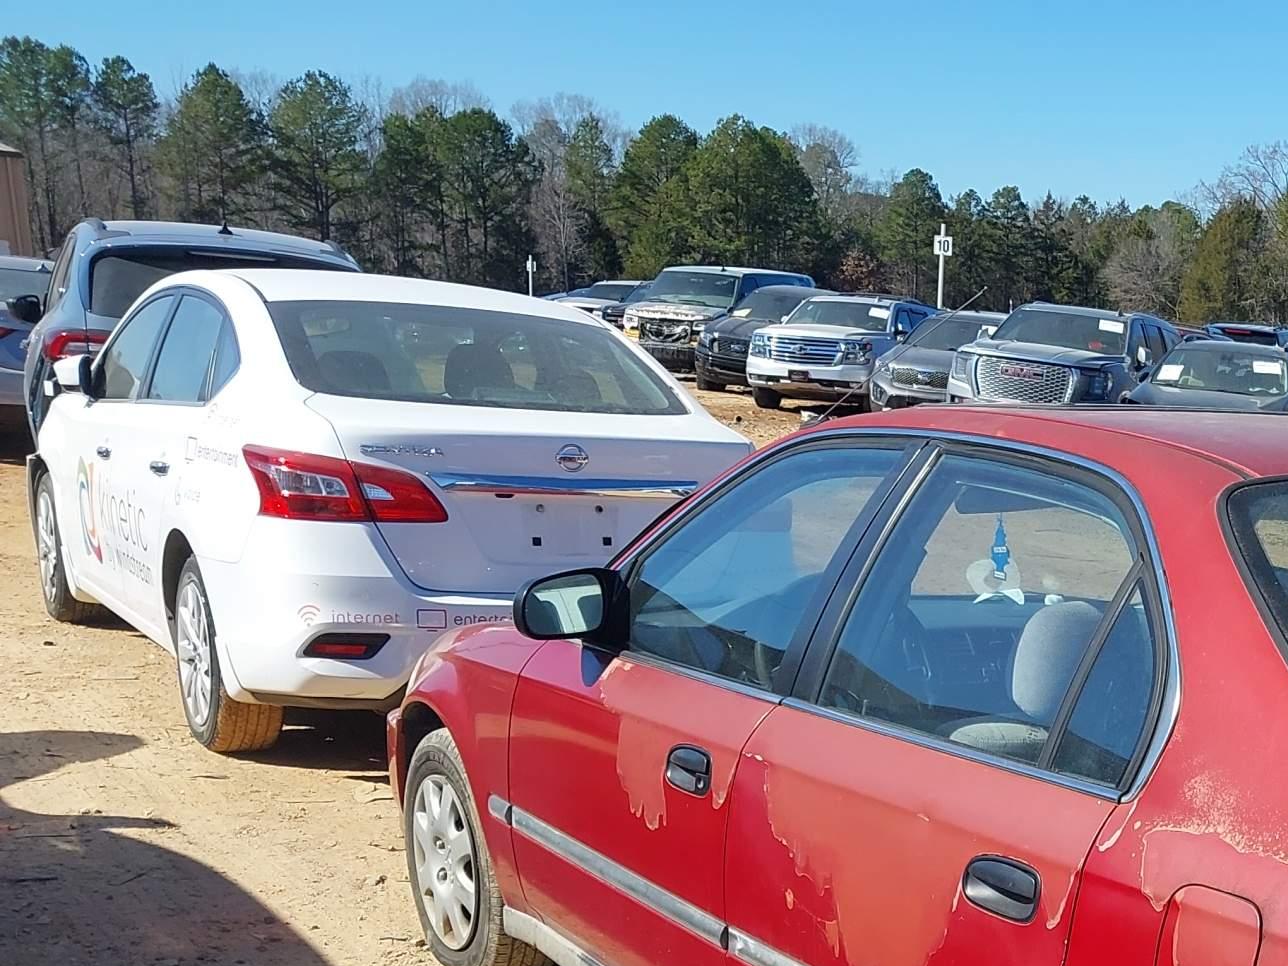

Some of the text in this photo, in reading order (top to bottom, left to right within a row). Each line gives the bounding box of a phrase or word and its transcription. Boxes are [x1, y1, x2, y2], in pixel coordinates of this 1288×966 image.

[937, 239, 950, 253] 10
[1001, 366, 1044, 381] GMC
[98, 471, 148, 552] kinetic
[331, 609, 400, 625] internet
[454, 612, 512, 626] entert
